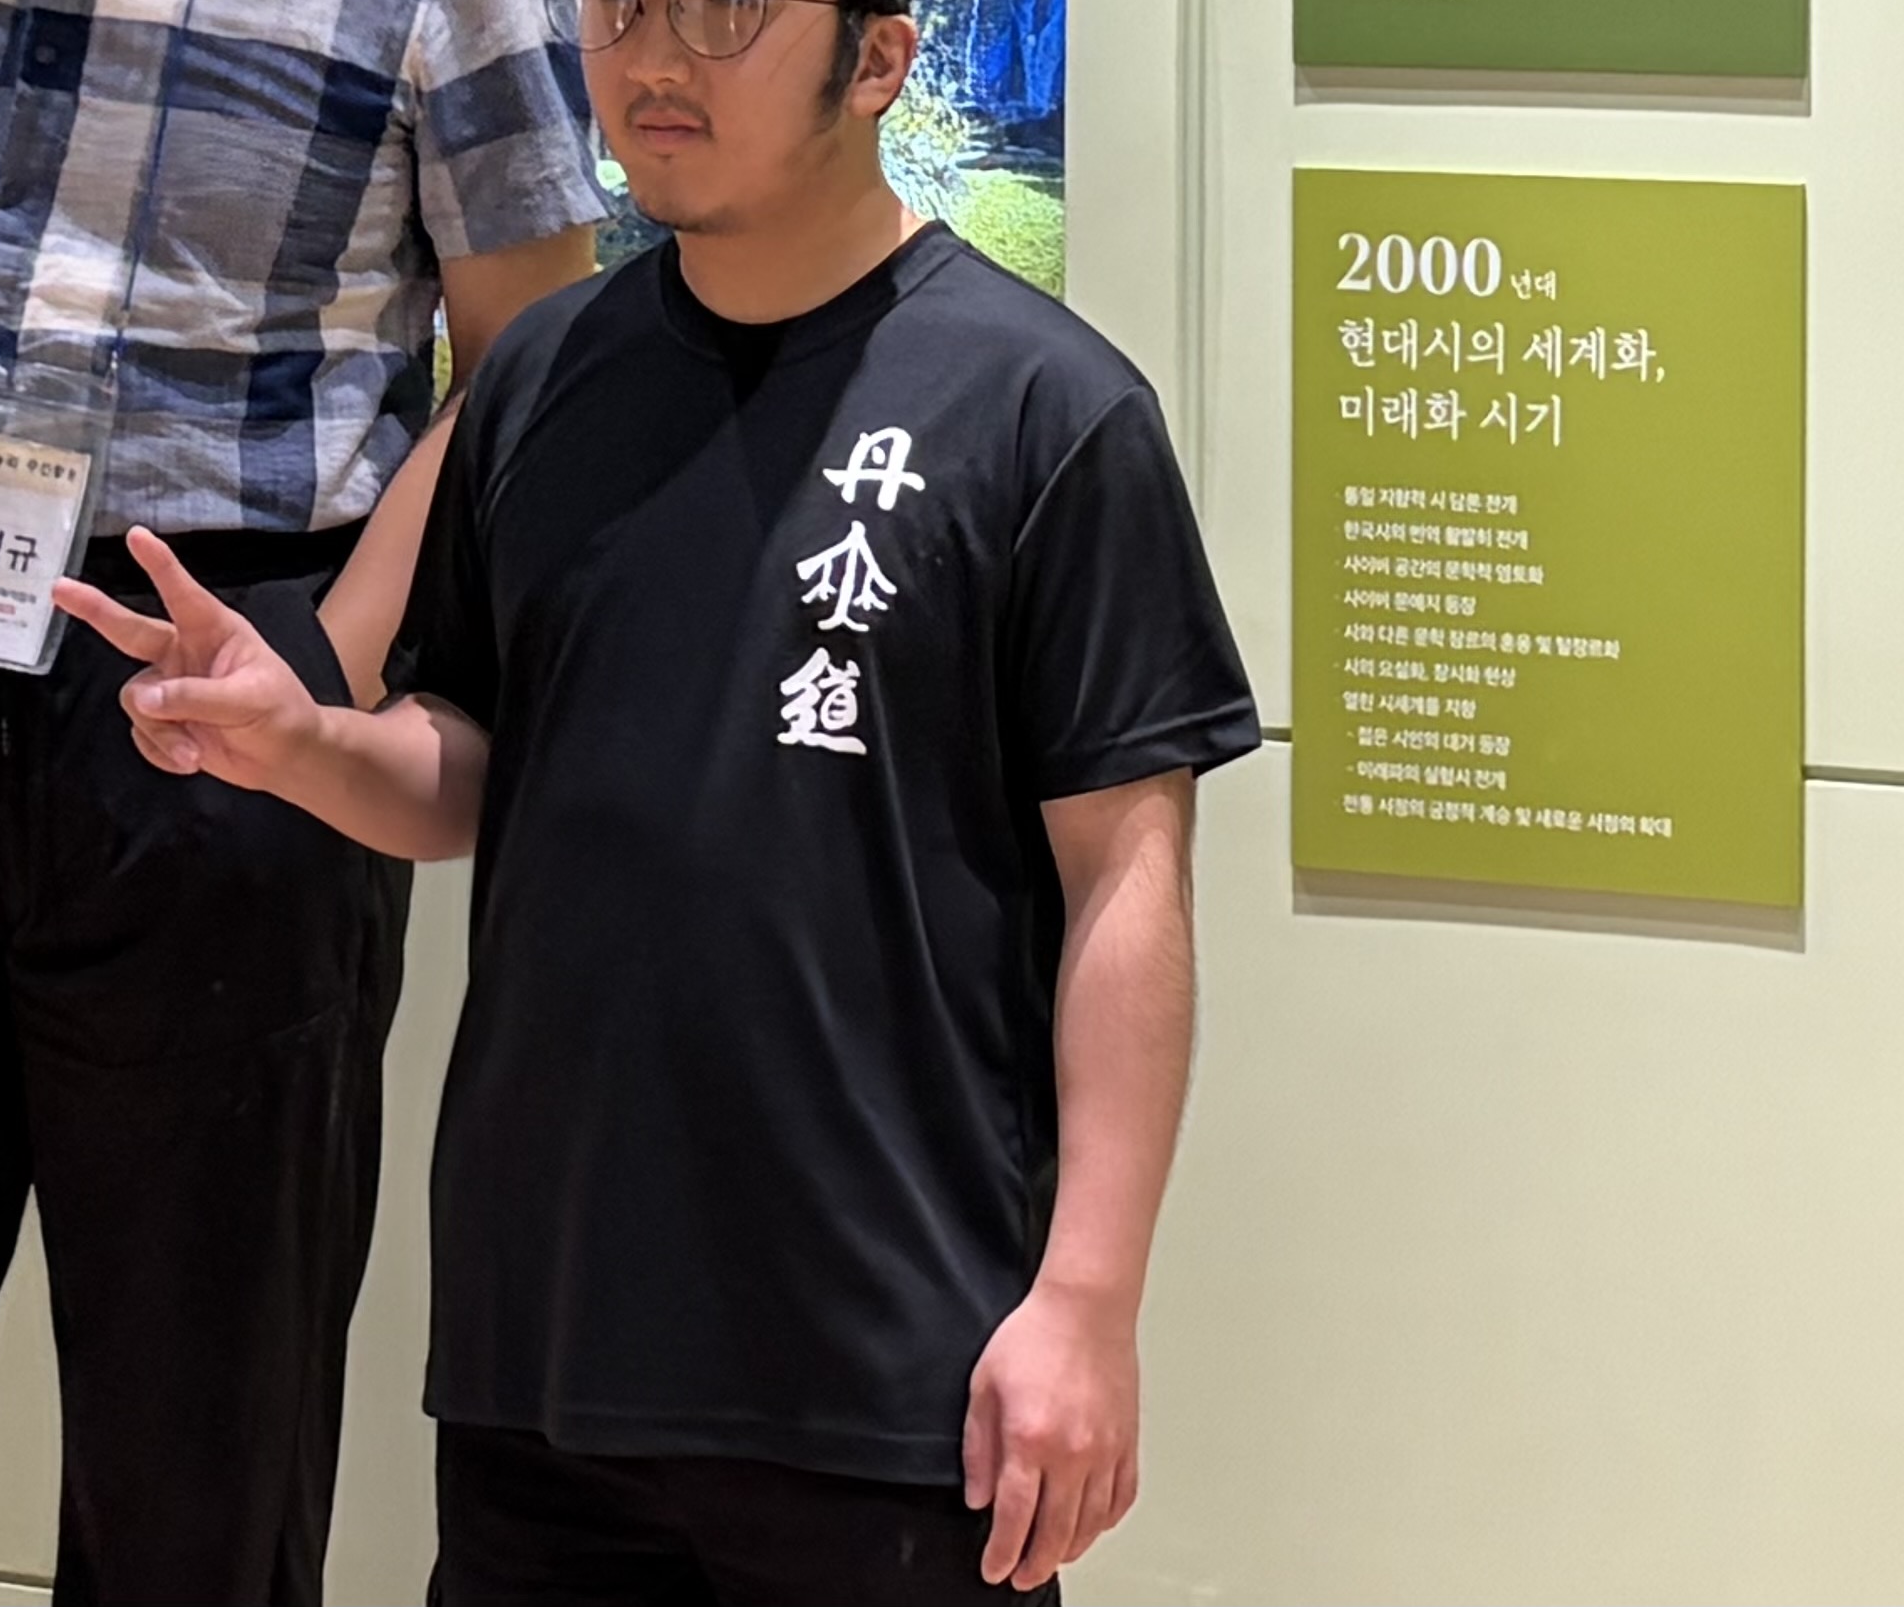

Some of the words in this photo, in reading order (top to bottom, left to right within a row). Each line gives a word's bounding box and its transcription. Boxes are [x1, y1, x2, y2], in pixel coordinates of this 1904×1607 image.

[1336, 232, 1502, 297] 2000
[1510, 268, 1556, 300] 년대
[1338, 317, 1504, 375] 현대시의
[1522, 324, 1665, 383] 세계화,
[1339, 385, 1467, 440] 미래화
[1479, 391, 1561, 447] 시기
